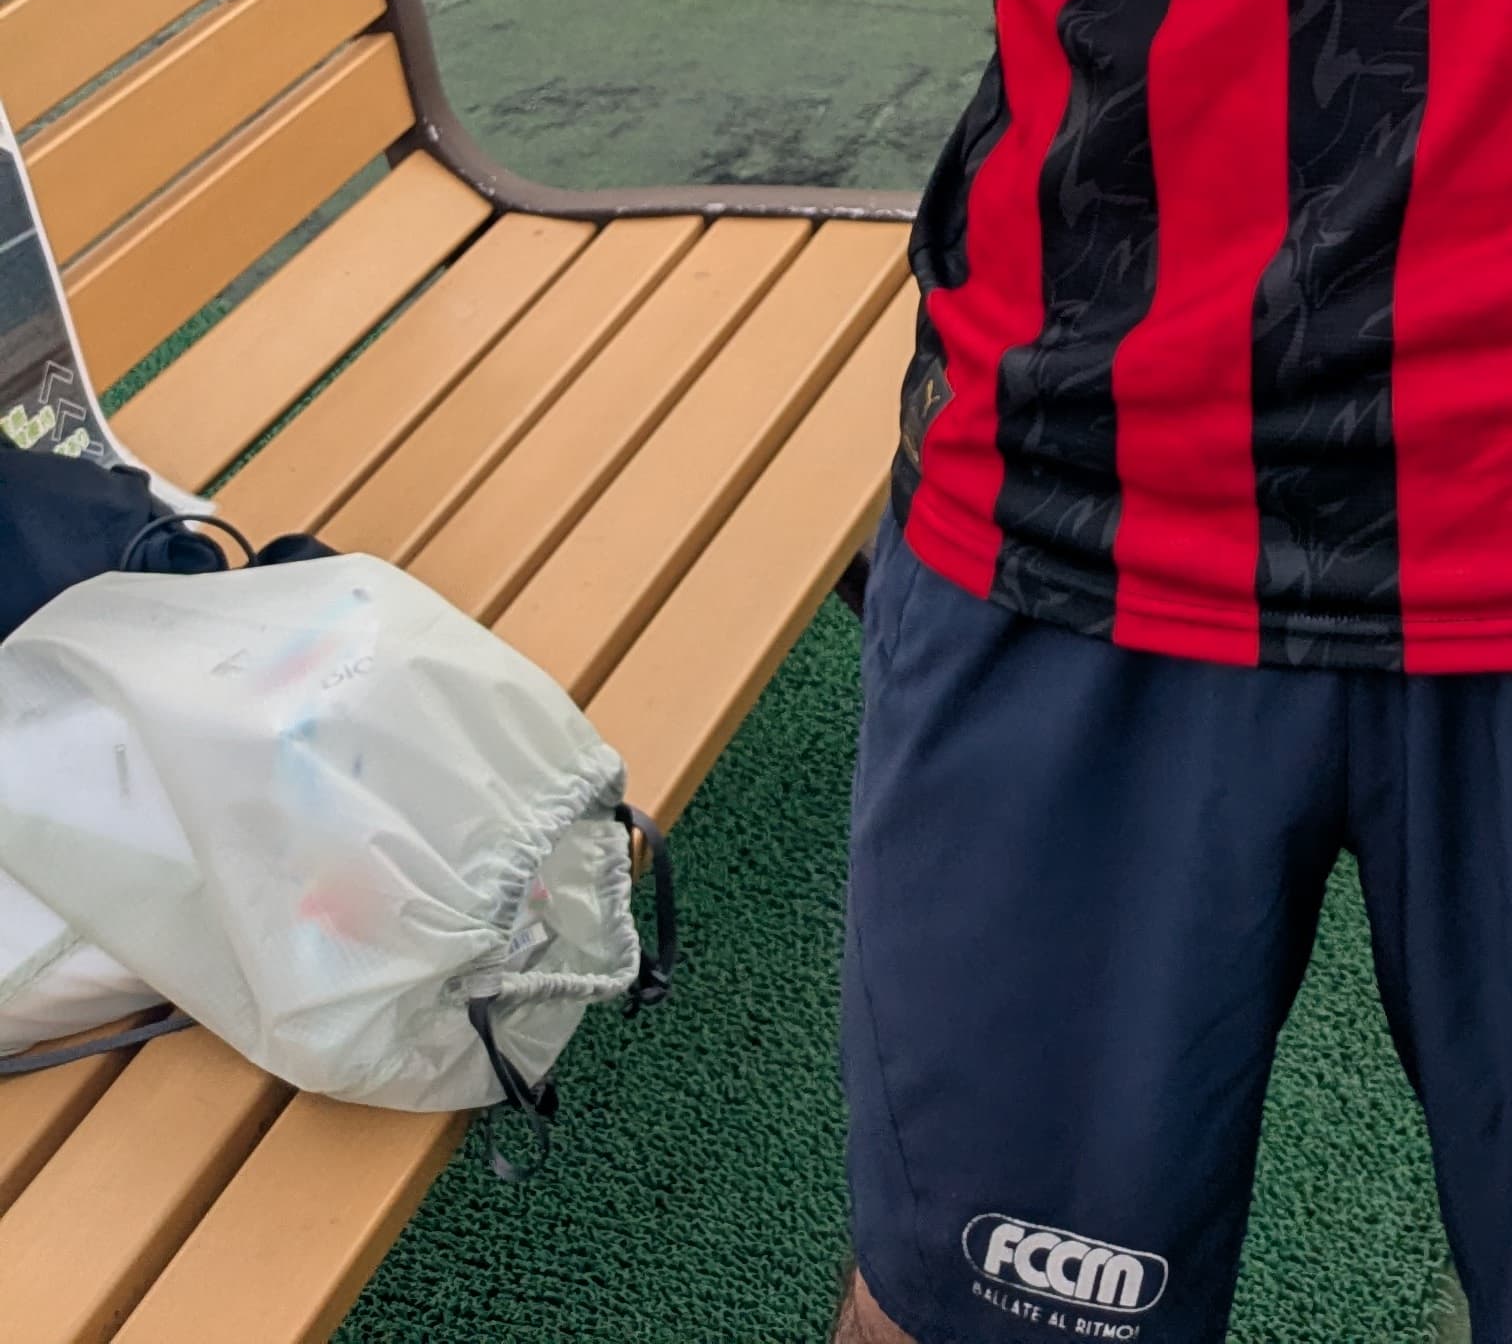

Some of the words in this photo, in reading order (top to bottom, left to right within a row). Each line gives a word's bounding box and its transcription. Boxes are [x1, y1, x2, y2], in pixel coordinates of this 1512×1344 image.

[972, 1281, 1042, 1322] BALLATE
[1047, 1312, 1066, 1329] AL
[1075, 1318, 1140, 1340] RITMO!
